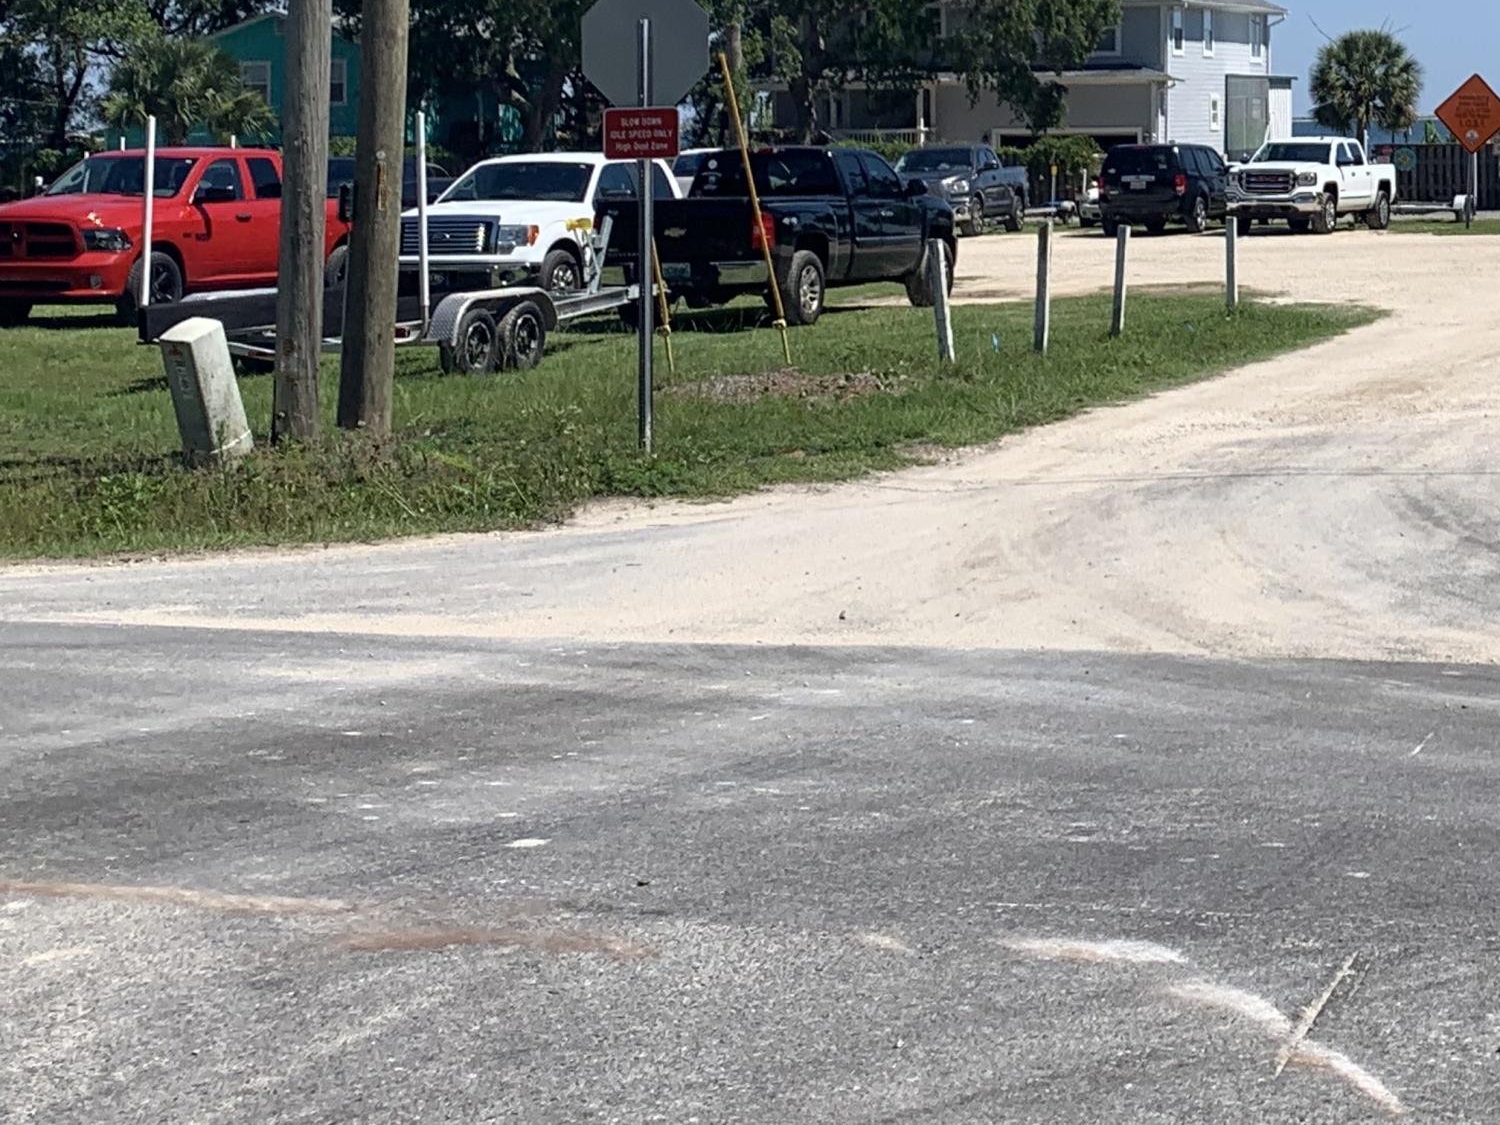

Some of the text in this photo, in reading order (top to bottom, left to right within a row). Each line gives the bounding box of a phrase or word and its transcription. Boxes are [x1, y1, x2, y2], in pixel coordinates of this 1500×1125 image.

[621, 116, 662, 127] SLOW DOWN
[610, 128, 673, 140] IDLE SPEED ONLY
[615, 141, 668, 153] High Dust Zone
